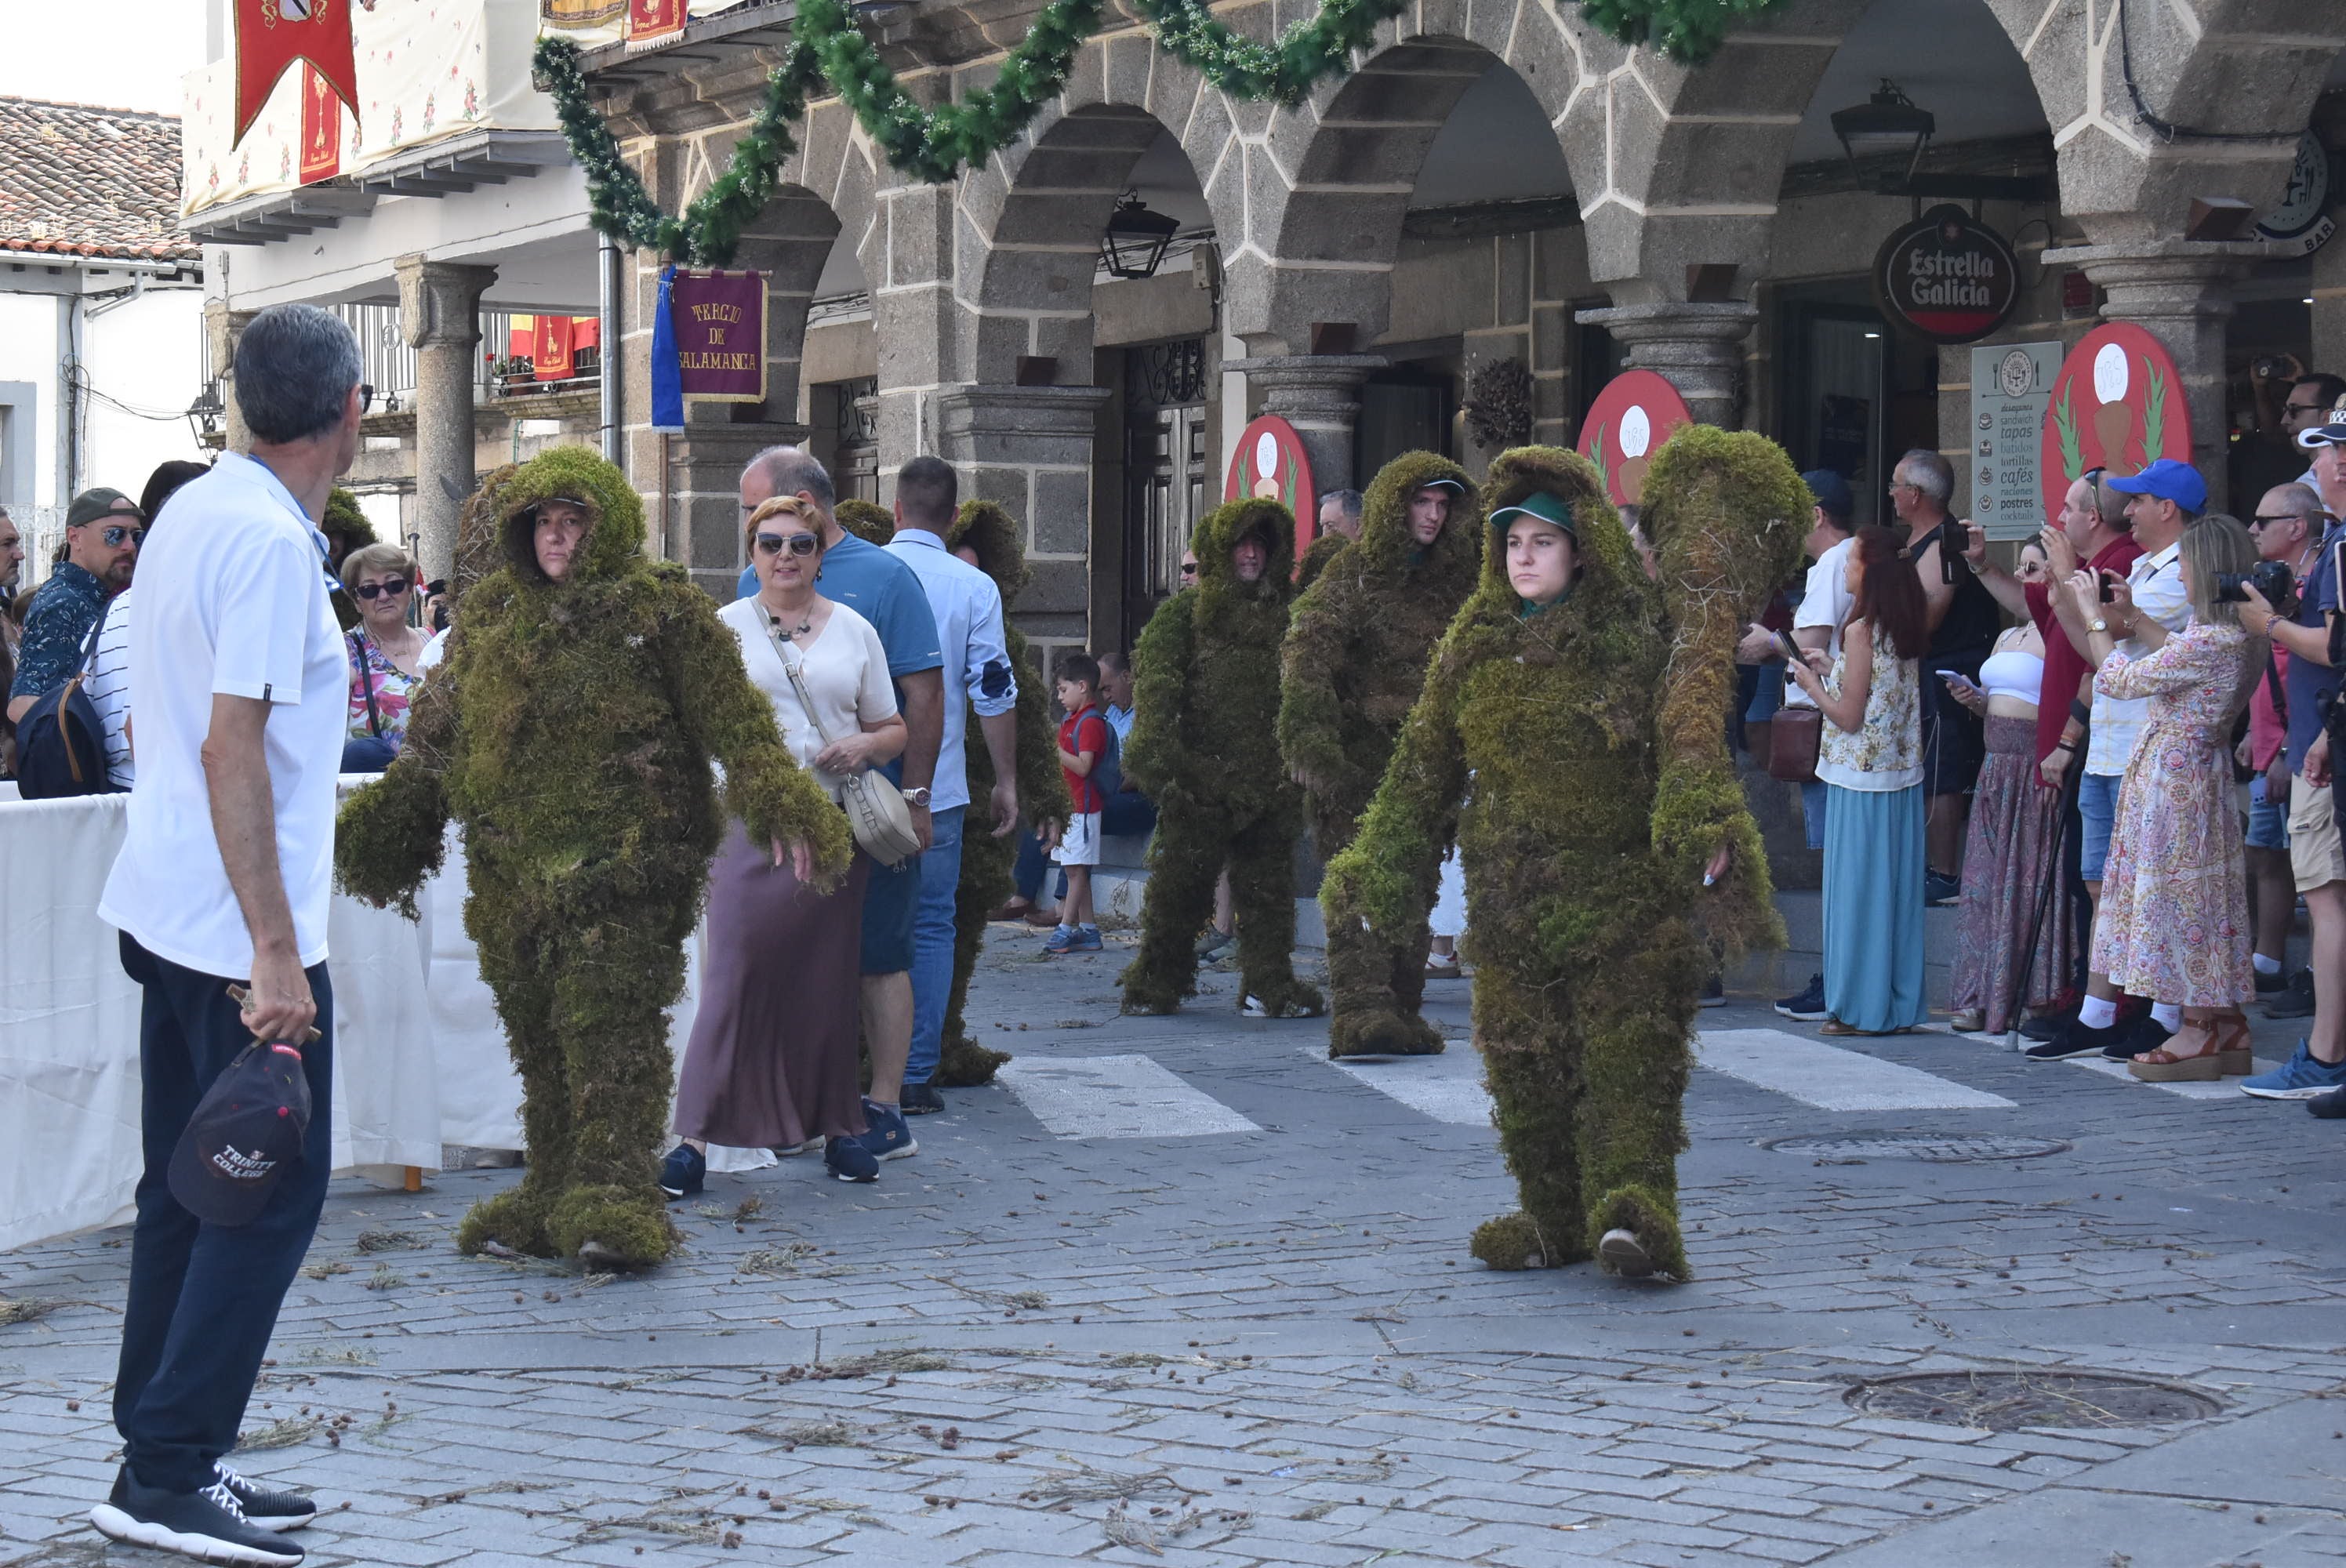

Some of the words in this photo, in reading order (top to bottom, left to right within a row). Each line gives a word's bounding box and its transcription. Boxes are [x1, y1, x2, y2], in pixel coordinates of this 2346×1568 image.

[2304, 223, 2333, 251] BAR
[1908, 248, 1994, 278] Estrella
[1911, 277, 1991, 306] Galicia
[691, 303, 742, 324] TERCIO
[708, 328, 725, 345] DE
[2001, 414, 2032, 425] sandwich
[2001, 426, 2032, 441] tapas
[2001, 441, 2032, 453] batidos
[2001, 455, 2032, 466] tortillas
[2001, 467, 2033, 486] cafés
[2001, 487, 2032, 496] raciones
[2001, 499, 2033, 510] postres
[2001, 510, 2033, 521] cocktails
[212, 1153, 267, 1178] COLLEGE
[223, 1144, 276, 1170] TRINITY
